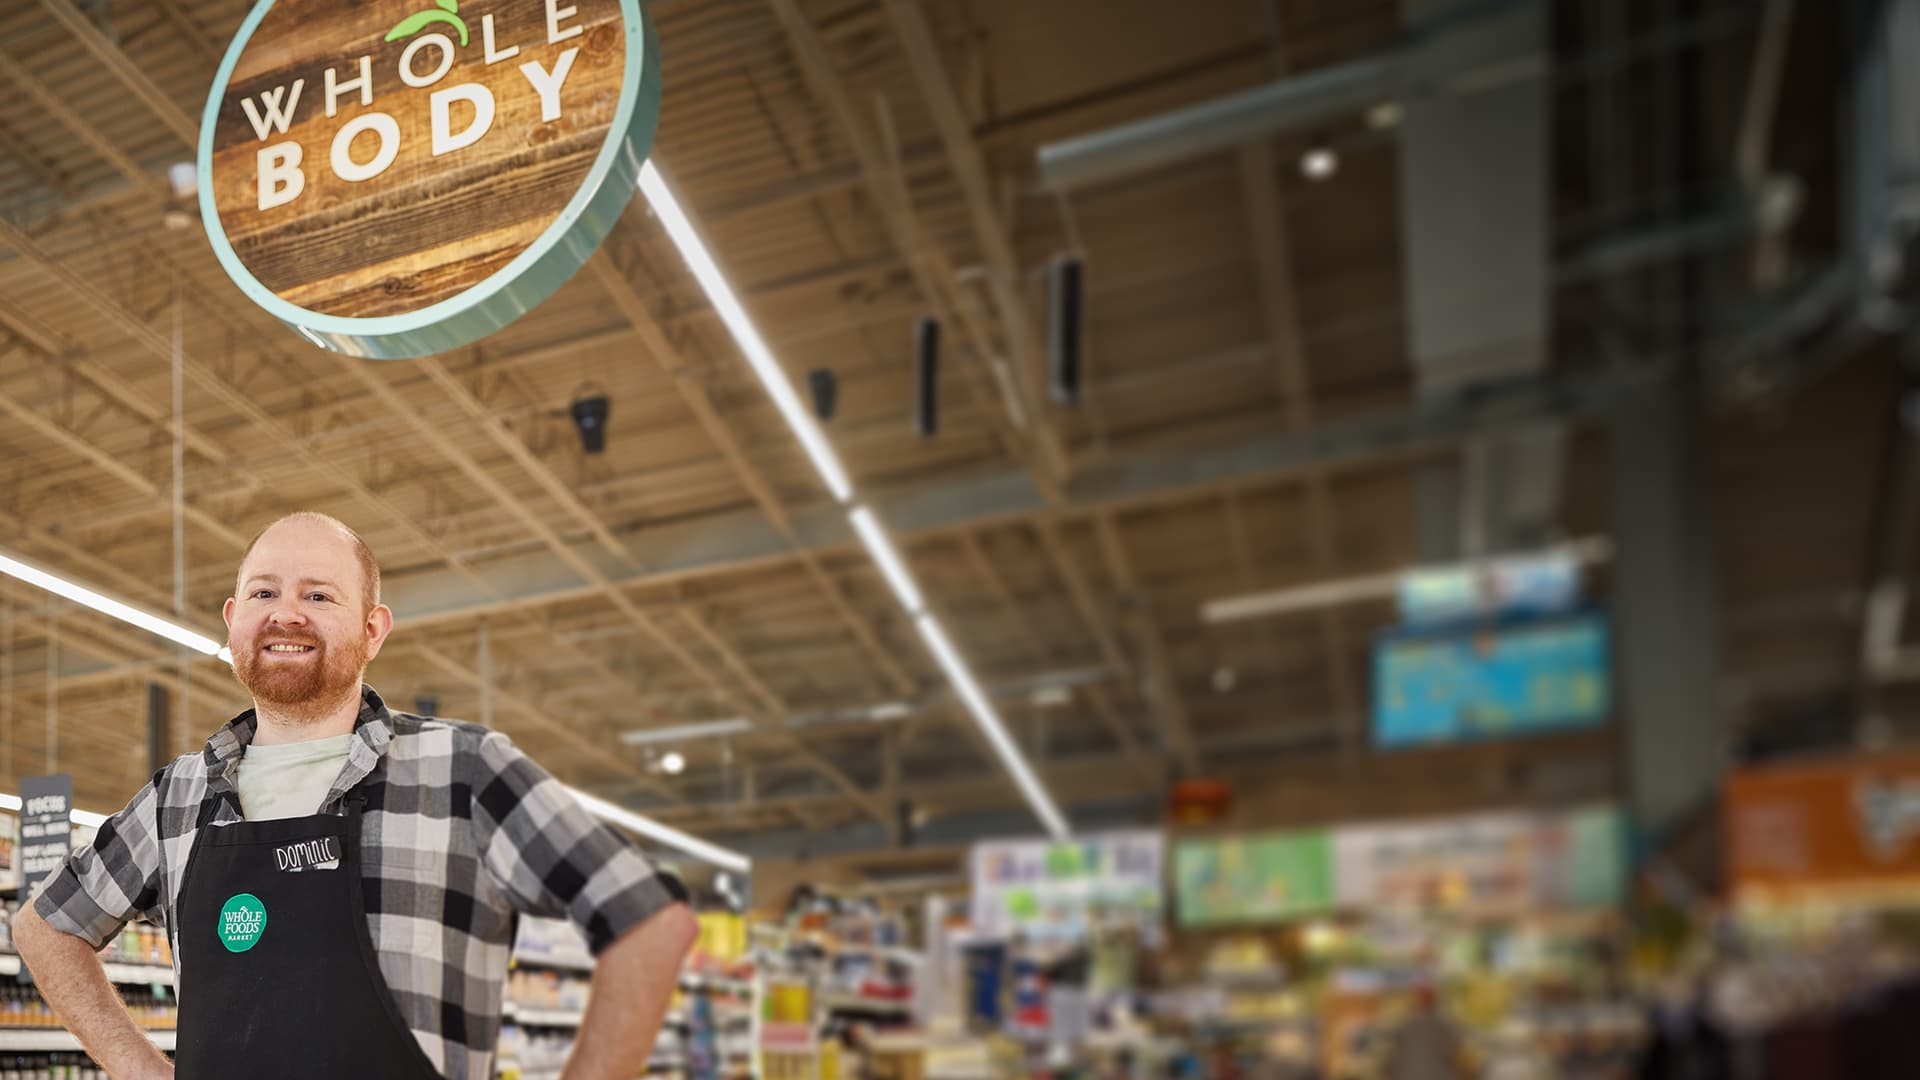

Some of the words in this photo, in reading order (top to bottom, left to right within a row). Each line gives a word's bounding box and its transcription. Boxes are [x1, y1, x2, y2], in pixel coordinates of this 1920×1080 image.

[241, 0, 583, 141] WHOLE
[257, 47, 579, 211] BODY
[224, 909, 263, 923] WHOLE
[224, 922, 260, 934] FOODS
